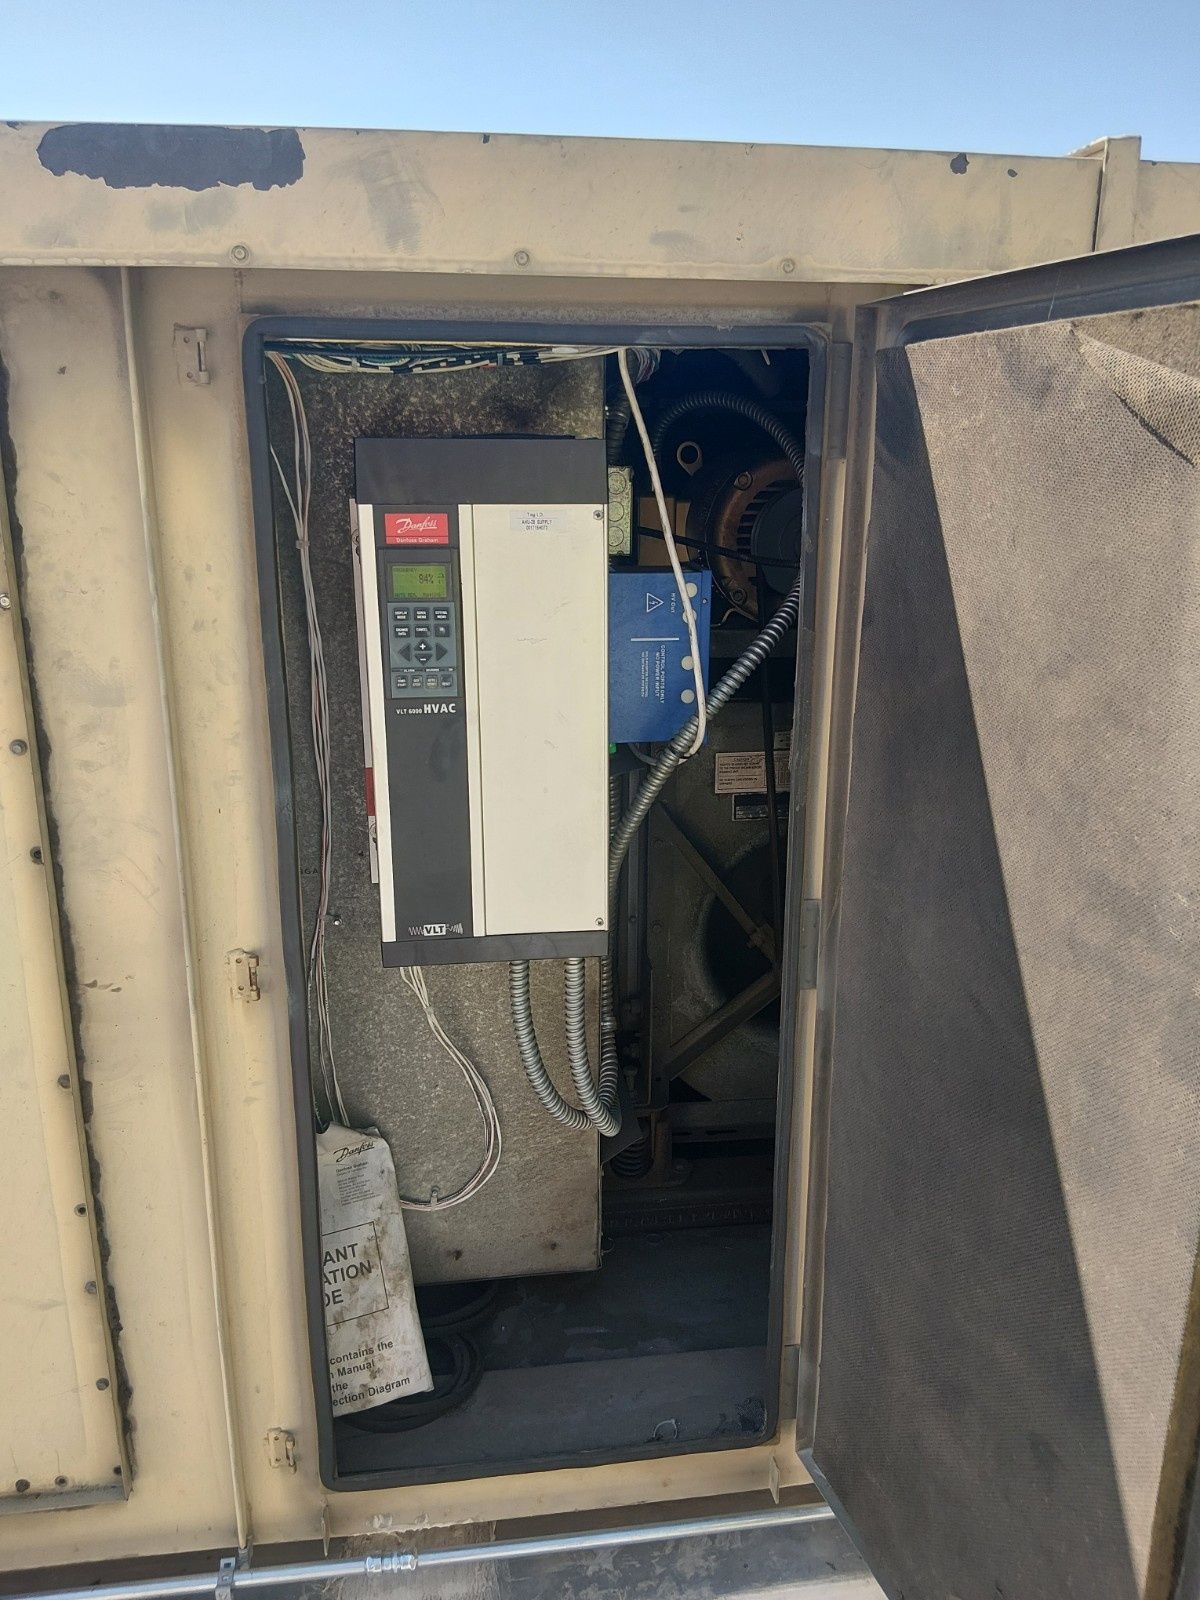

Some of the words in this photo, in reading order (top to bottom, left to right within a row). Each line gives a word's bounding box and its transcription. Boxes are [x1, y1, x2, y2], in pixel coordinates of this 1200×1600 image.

[395, 516, 438, 534] Danfoss
[423, 703, 457, 714] HVAC
[424, 925, 445, 935] VLT
[333, 1141, 375, 1163] Danfoss
[329, 1347, 375, 1365] contains
[377, 1340, 394, 1352] the
[337, 1358, 376, 1377] Manual
[332, 1382, 349, 1394] the
[368, 1377, 411, 1397] Diagram
